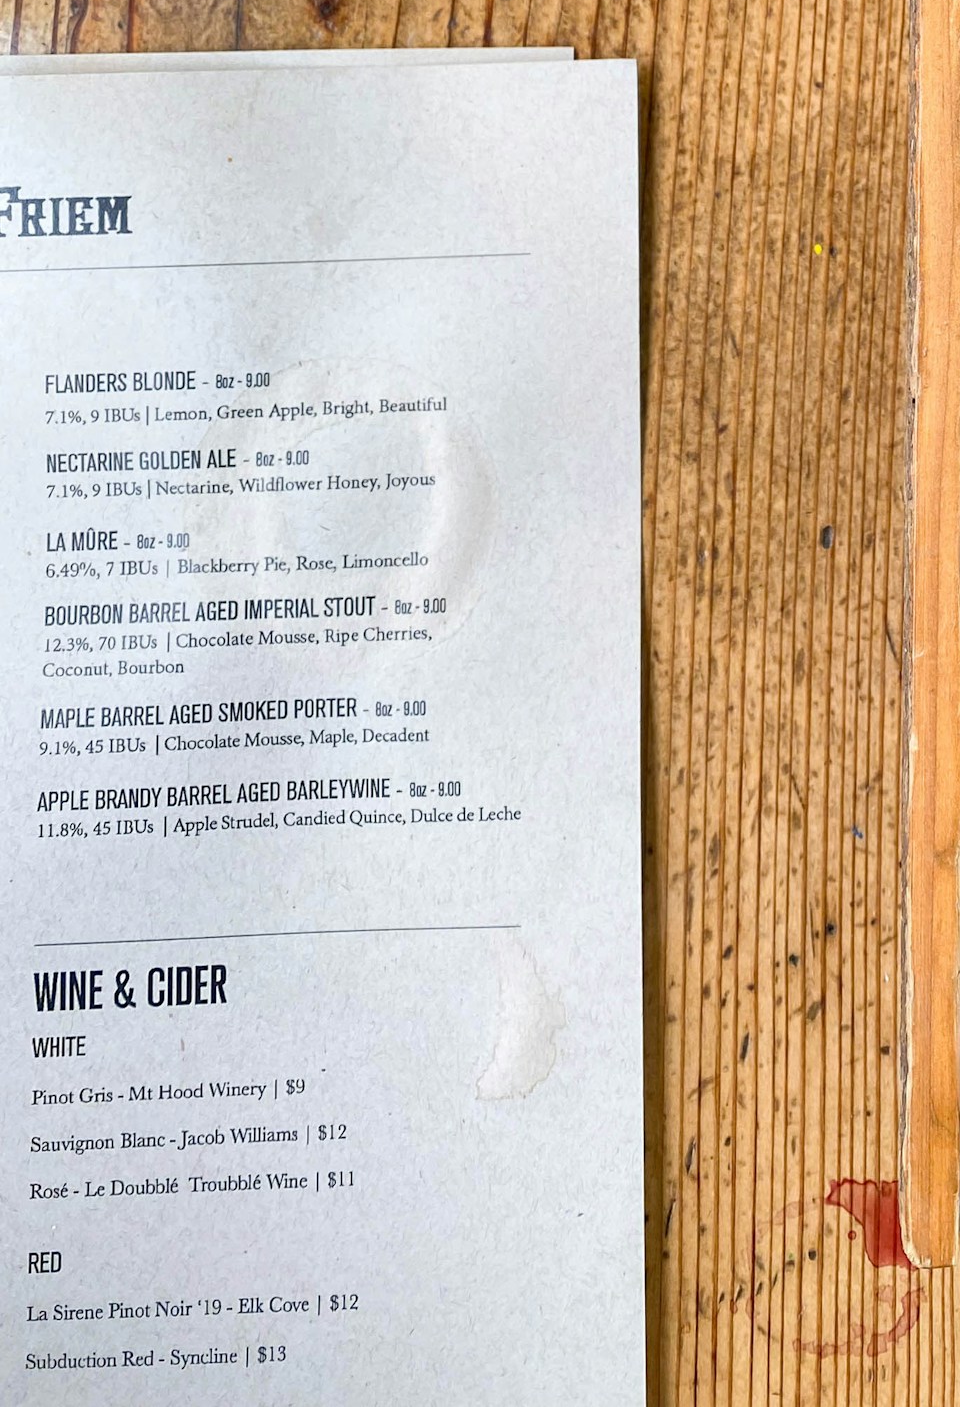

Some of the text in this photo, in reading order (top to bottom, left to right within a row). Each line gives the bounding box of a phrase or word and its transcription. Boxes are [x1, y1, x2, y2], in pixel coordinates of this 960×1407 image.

[45, 372, 127, 394] FLANDERS
[133, 370, 196, 392] BLONDE
[245, 371, 270, 388] 9.00
[44, 396, 447, 426] 7.1%, 9 IBUs Lemon, Green Apple, Bright, Beautiful
[46, 451, 134, 473] NECTARINE
[139, 449, 201, 470] GOLDEN
[206, 448, 237, 469] ALE
[285, 449, 309, 466] 9.00
[46, 472, 436, 500] 7.1%, 9 IBUs Nectarine, Wildflower Honey, Joyous
[46, 531, 66, 552] LA
[71, 527, 118, 552] MÛRE
[166, 532, 190, 551] 9.00
[45, 550, 429, 580] 6.49%, 7 IBUs Blackberry Pie, Rose, Limoncello
[44, 603, 123, 627] BOURBON
[128, 601, 190, 624] BARREL
[194, 599, 239, 622] AGED
[244, 597, 320, 620] IMPERIAL
[323, 595, 376, 618] STOUT
[423, 597, 446, 614] 9.00
[44, 626, 432, 653] 12.3%, 70 IBUs Chocolate Mousse, Ripe Cherries,
[42, 658, 185, 678] Coconut, Bourbon
[40, 706, 95, 729] MAPLE
[100, 704, 164, 727] BARREL
[168, 703, 213, 725] AGED
[218, 699, 288, 723] SMOKED
[294, 697, 357, 719] PORTER
[403, 699, 426, 716] 9.00
[39, 726, 430, 757] 9.1%, 45 IBUs Chocolate Mousse, Maple, Decadent
[36, 789, 89, 812] APPLE
[95, 786, 162, 810] BRANDY
[166, 783, 232, 807] BARREL
[236, 781, 280, 804] AGED
[286, 777, 390, 801] BARLEYWINE
[438, 780, 461, 797] 9.00
[38, 805, 521, 839] 11.8%, 45 IBUs Apple Strudel, Candied Quince, Dulce de Leche
[33, 963, 227, 1012] WINE & CIDER
[31, 1035, 86, 1058] WHITE
[30, 1078, 305, 1106] Pinot Gris Mt Hood Winery $9
[30, 1123, 347, 1156] Sauvignon Blanc Jacob Williams $12
[29, 1170, 354, 1200] Rosé Le Doubblé Troubblé Wine $11
[28, 1250, 62, 1274] RED
[26, 1305, 48, 1322] La
[52, 1304, 103, 1321] Sirene
[107, 1302, 151, 1319] Pinot
[154, 1299, 193, 1318] Noir
[237, 1296, 264, 1314] Elk
[269, 1296, 309, 1313] Cove
[329, 1293, 359, 1312] $12
[25, 1345, 286, 1370] Subduction Red Syncline $13
